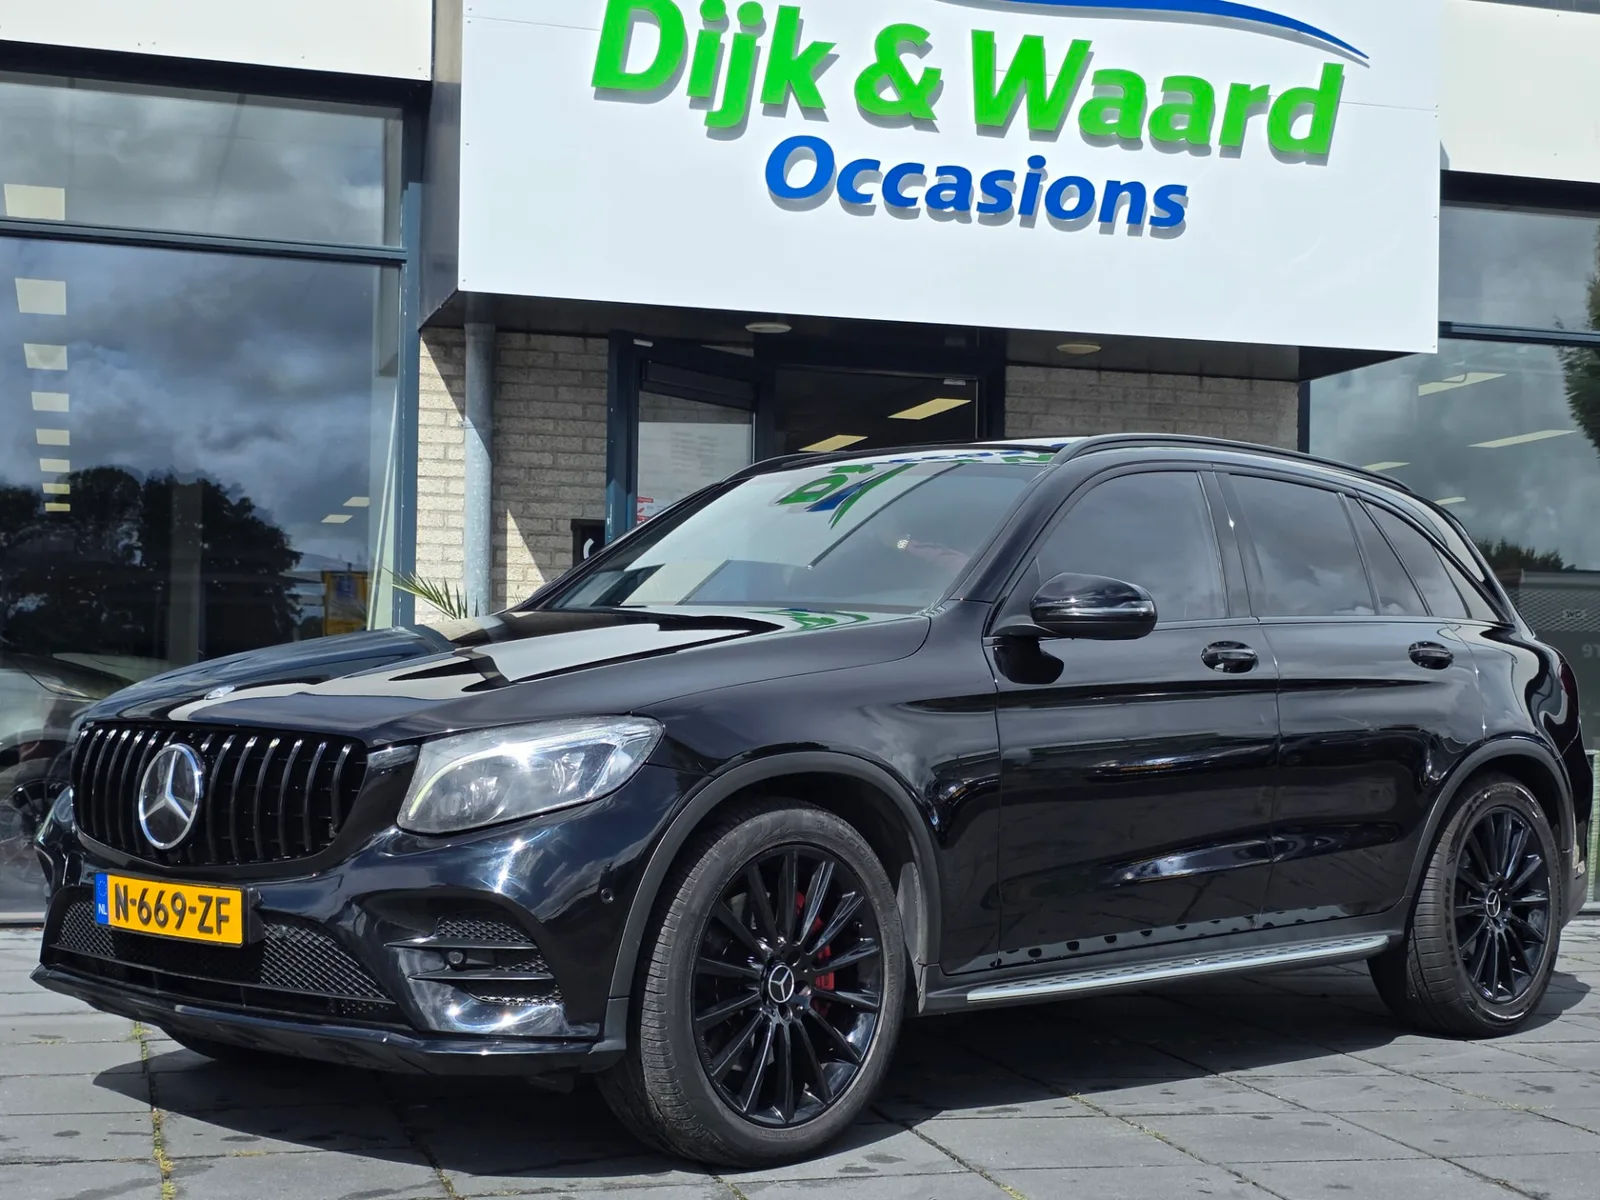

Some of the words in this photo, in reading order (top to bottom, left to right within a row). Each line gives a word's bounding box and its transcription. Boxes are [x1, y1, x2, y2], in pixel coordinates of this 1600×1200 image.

[592, 0, 834, 127] Dijk
[856, 24, 941, 119] &
[972, 30, 1342, 153] Waard
[765, 135, 1188, 229] Occasions
[97, 903, 108, 916] NL
[114, 883, 231, 936] N-669-ZF
